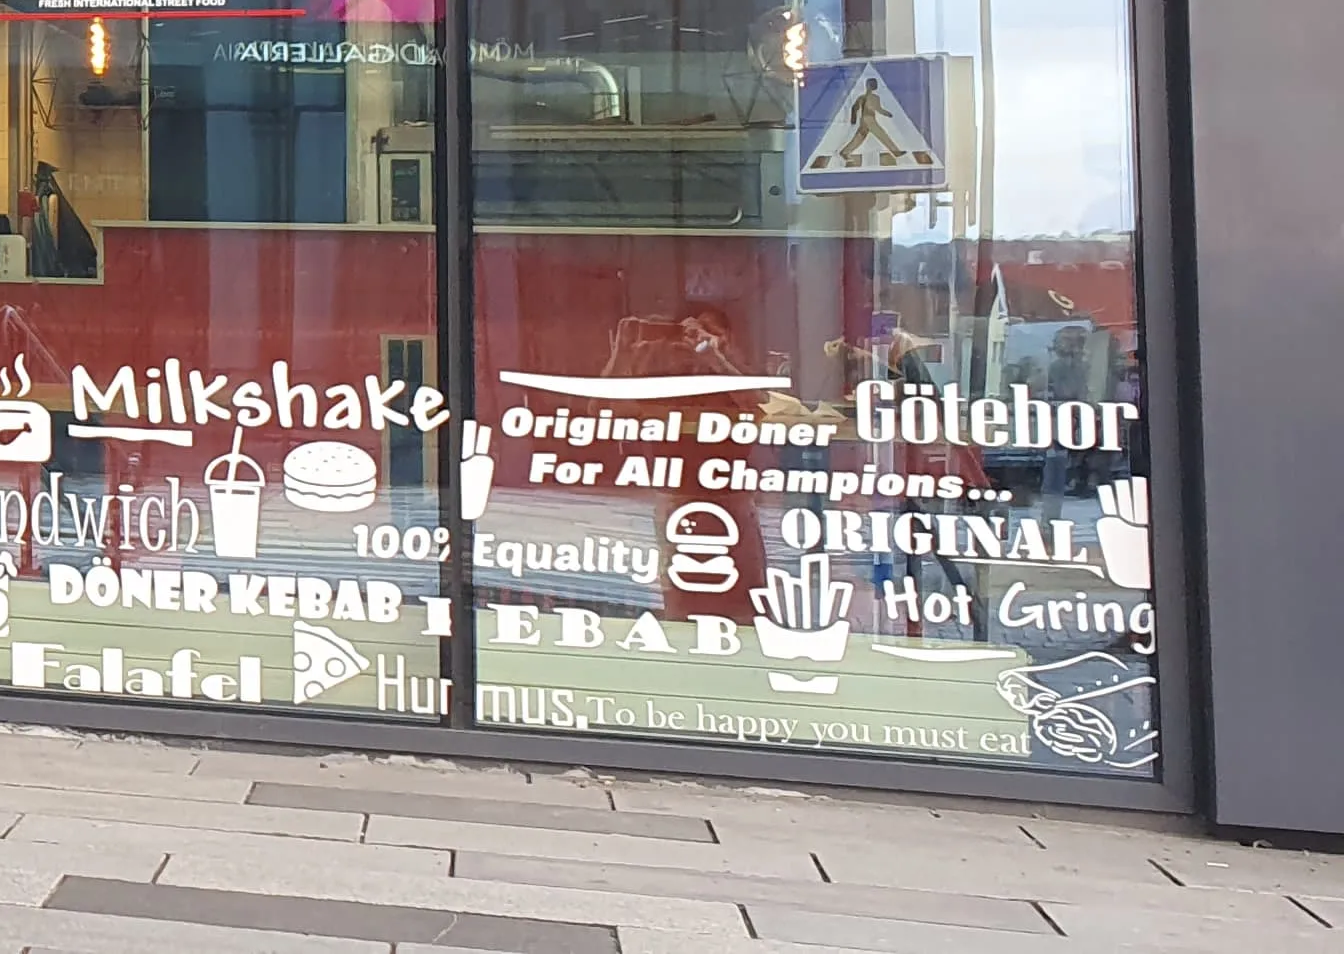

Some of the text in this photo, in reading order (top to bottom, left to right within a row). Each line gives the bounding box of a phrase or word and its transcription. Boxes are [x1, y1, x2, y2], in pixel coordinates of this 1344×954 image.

[38, 0, 72, 8] FRESH
[70, 358, 450, 432] Milkshake
[856, 379, 1139, 451] Götebor
[501, 406, 838, 447] Original Döner
[529, 453, 1013, 502] For All Champions...
[473, 533, 660, 585] Equality
[781, 507, 1088, 563] ORIGINAL
[48, 556, 404, 624] DÖNER KEBAB
[883, 576, 1157, 655] Hot Gring
[12, 642, 262, 705] Falafel
[586, 697, 1033, 757] To be happy you must eat
